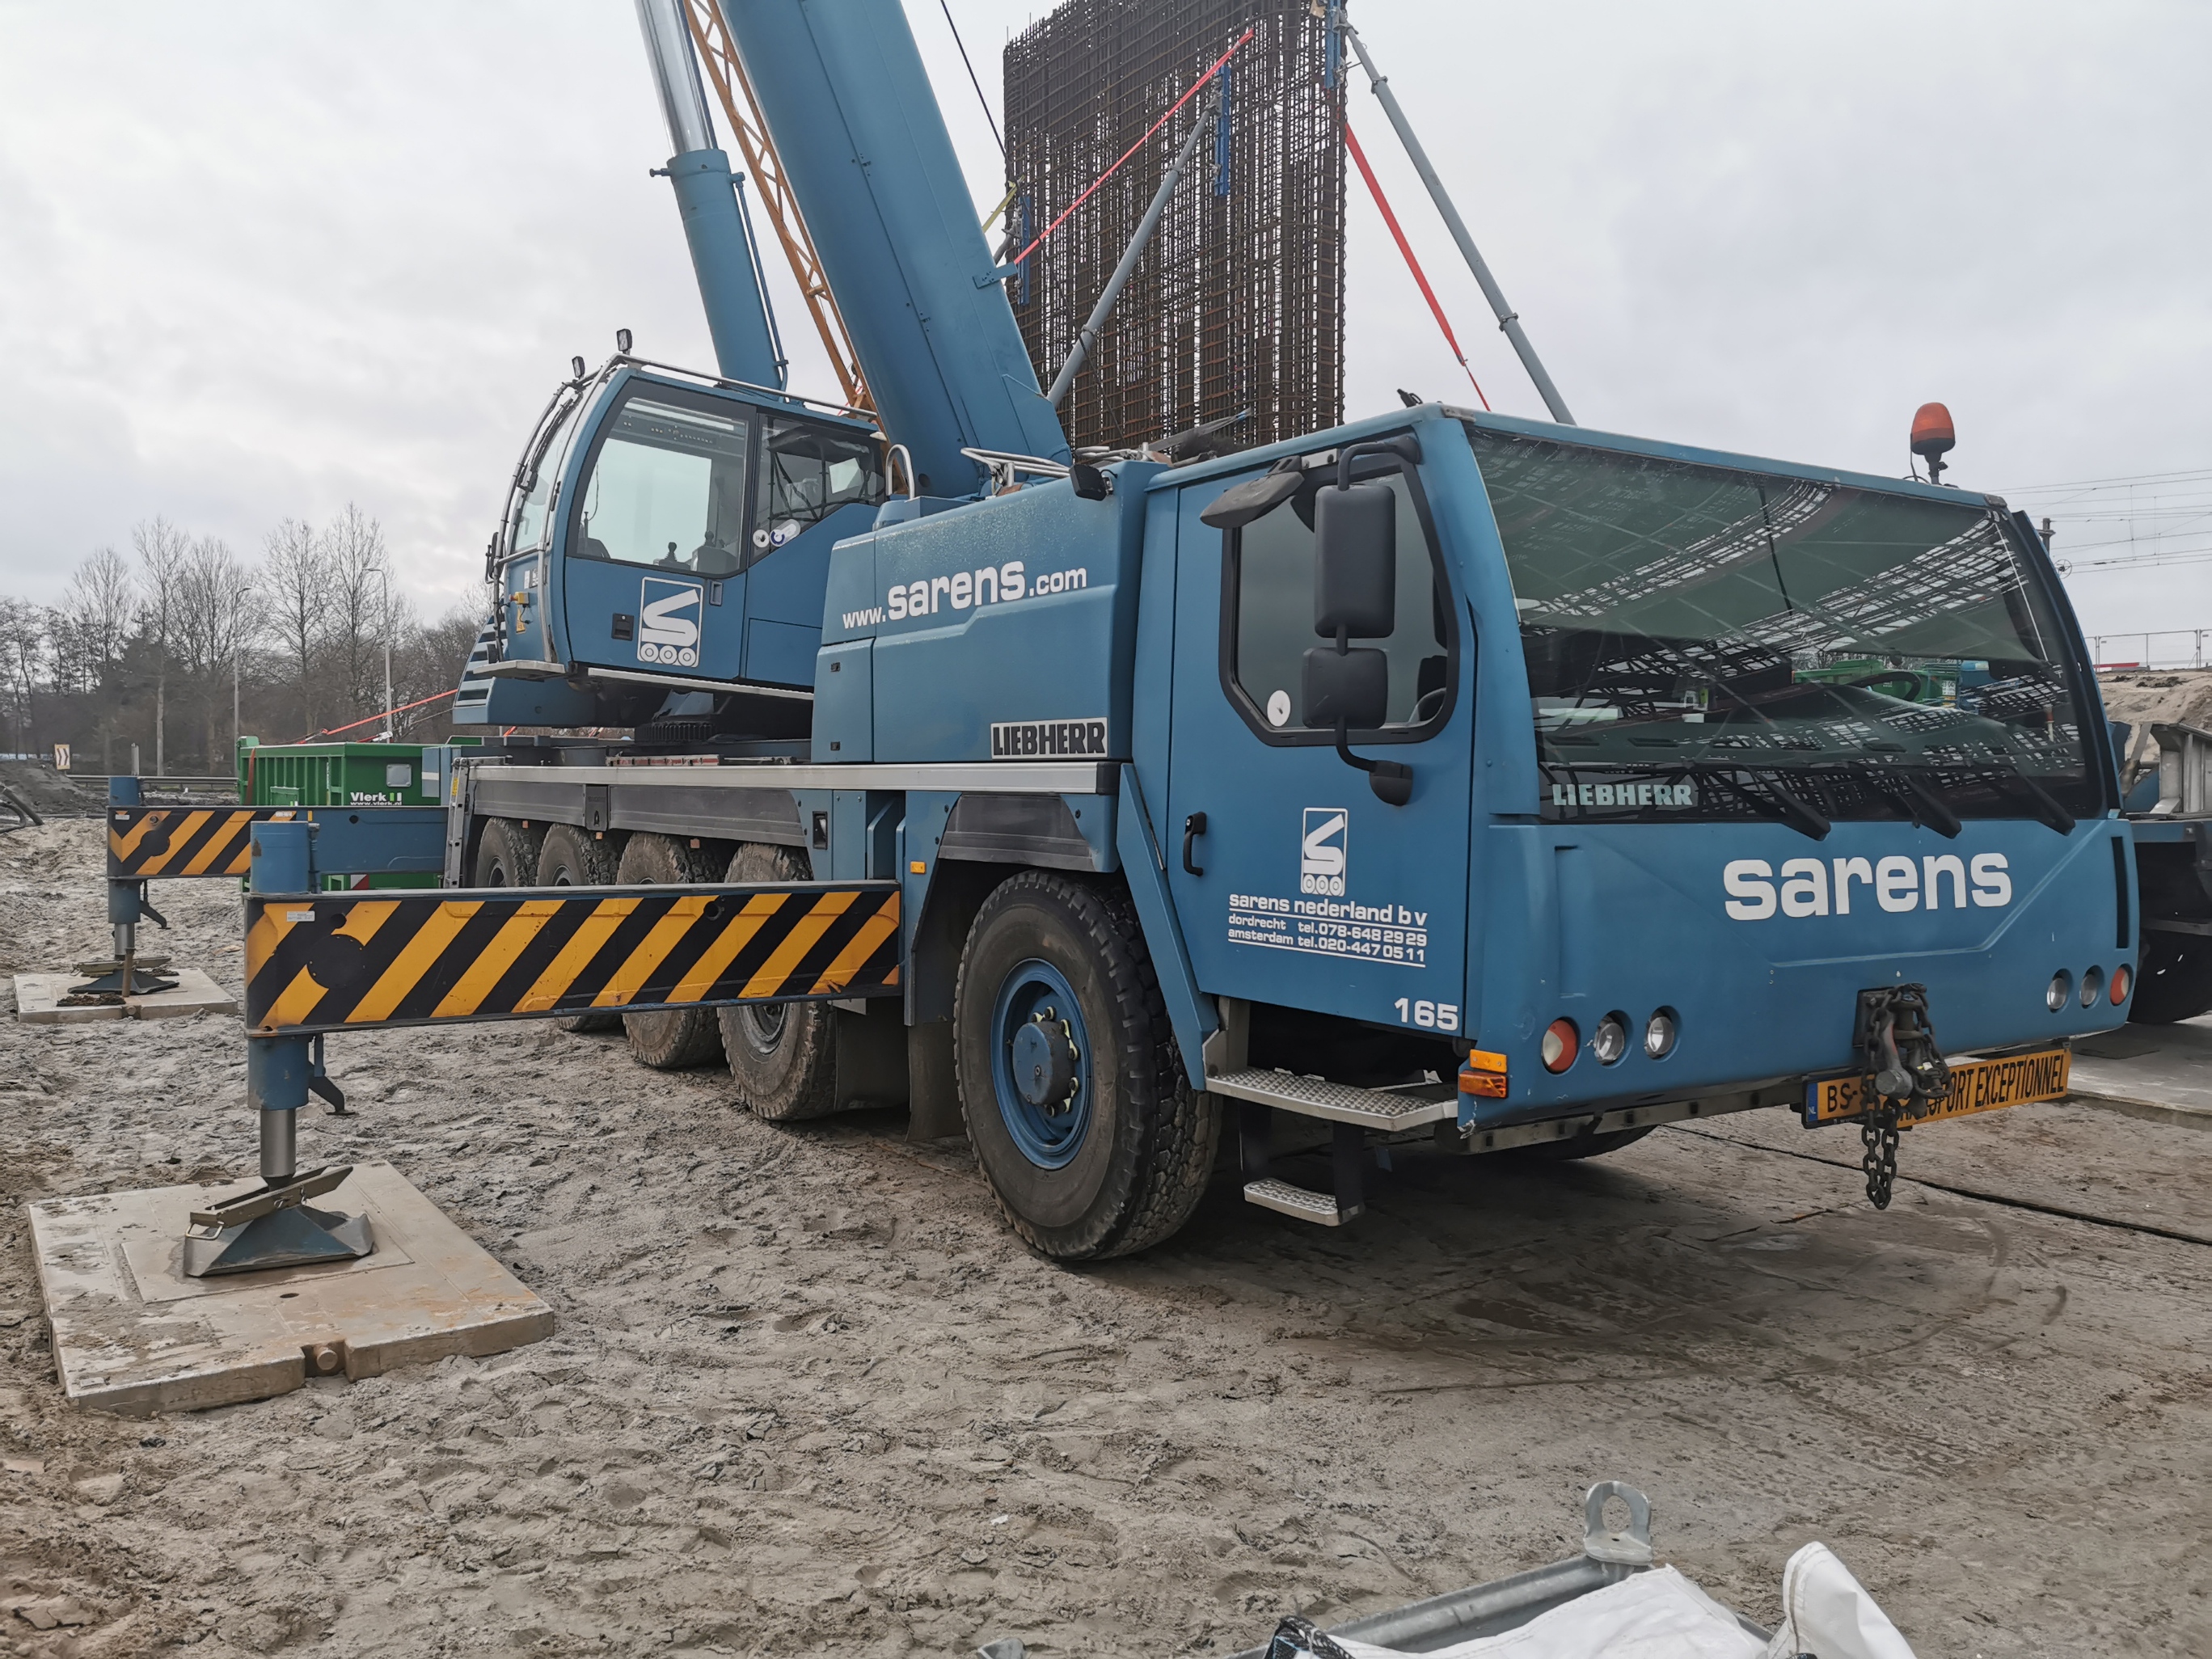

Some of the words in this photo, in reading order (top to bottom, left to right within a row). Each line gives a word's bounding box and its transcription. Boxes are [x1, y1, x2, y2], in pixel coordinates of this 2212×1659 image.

[842, 560, 1087, 629] www.sarens.com
[993, 721, 1106, 756] LIEBHERR
[1553, 783, 1693, 806] LIEBHERR
[1723, 852, 2013, 921] sarens
[1228, 914, 1286, 931] dordrecht
[1229, 893, 1290, 912] sarens
[1294, 898, 1392, 923] nederland
[1227, 928, 1294, 945] amsterdam
[1394, 997, 1458, 1032] 165
[1974, 1053, 2065, 1108] EXCEPTIONNEL
